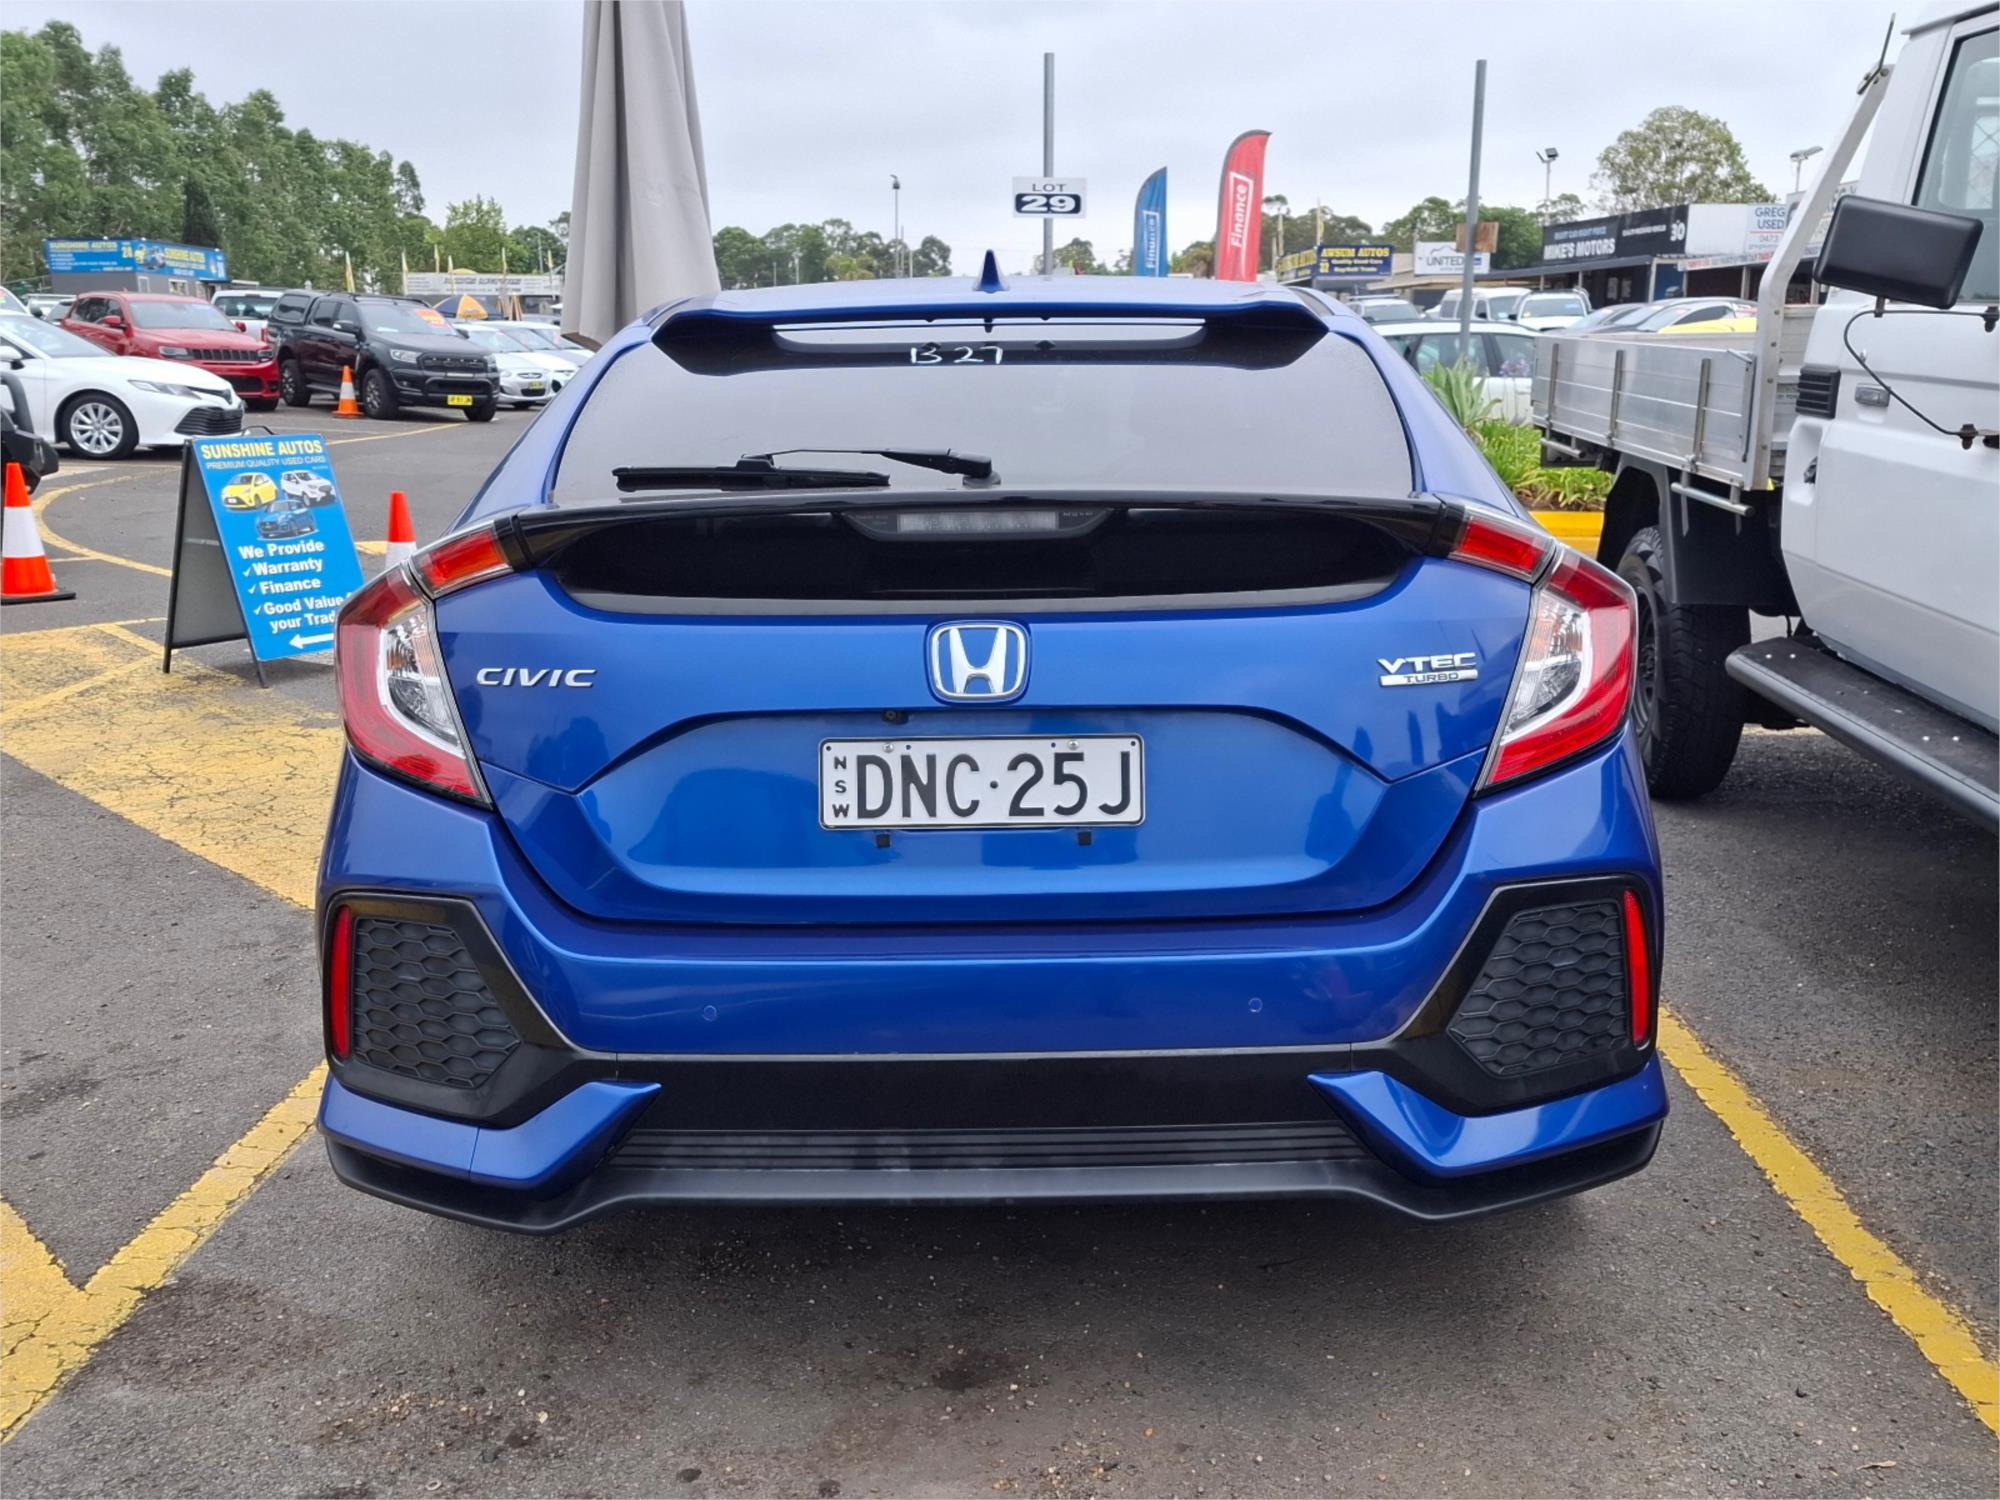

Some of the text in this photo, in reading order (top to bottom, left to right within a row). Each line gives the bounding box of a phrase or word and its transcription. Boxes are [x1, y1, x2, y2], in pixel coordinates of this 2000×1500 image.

[1032, 183, 1067, 192] LOT
[1021, 195, 1076, 212] 29
[1755, 207, 1786, 217] GREG
[1230, 184, 1249, 248] Finance
[1757, 219, 1785, 229] USED
[1670, 222, 1686, 241] 30
[1145, 219, 1156, 268] Finance
[1358, 248, 1390, 257] AUTOS
[1543, 239, 1616, 260] MIKE'S MOTORS
[1426, 256, 1465, 266] UNITED
[201, 440, 322, 459] SUNSHINE AUTOS
[206, 455, 326, 470] PREMIUM QUALITY USED CARS
[238, 540, 325, 559] We Provide
[252, 558, 323, 576] Warranty
[259, 578, 321, 595] Finance
[264, 595, 344, 615] Good Value
[270, 610, 336, 634] your Trad
[1377, 652, 1477, 674] VTEC
[476, 667, 597, 687] CIVIC
[1403, 672, 1459, 683] TURBO
